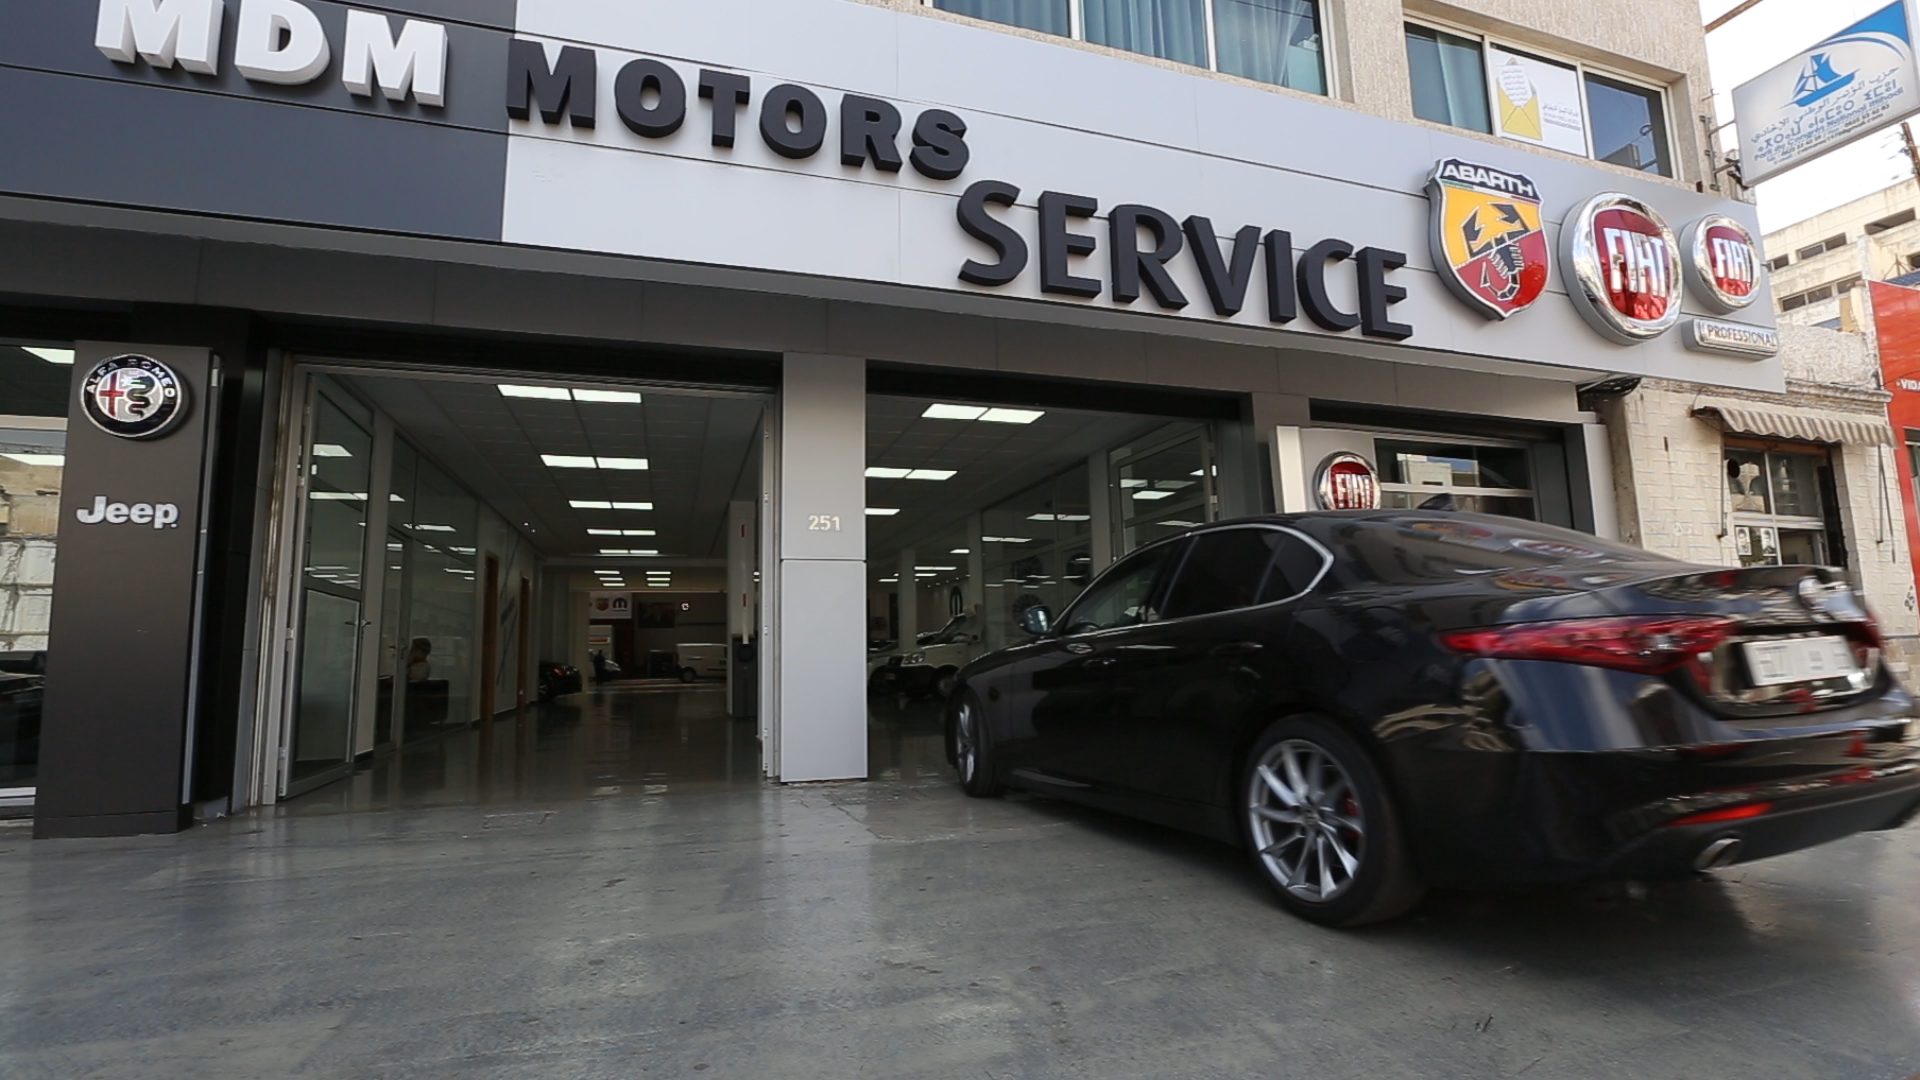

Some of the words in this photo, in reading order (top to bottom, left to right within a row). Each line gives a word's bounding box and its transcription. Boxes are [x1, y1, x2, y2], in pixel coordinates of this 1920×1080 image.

[95, 0, 449, 108] MDM
[506, 36, 969, 182] MOTORS
[1442, 162, 1535, 197] ABARTH
[957, 179, 1413, 342] SERVICE
[1602, 226, 1667, 298] FIAT
[1713, 236, 1752, 283] FIAT
[1706, 323, 1778, 347] PROFESSIONAL
[86, 361, 119, 395] ALFA
[127, 358, 176, 398] ROMEO
[1900, 377, 1920, 391] VID
[1335, 473, 1372, 509] FIAT
[76, 495, 178, 530] Jeep
[808, 514, 841, 531] 251
